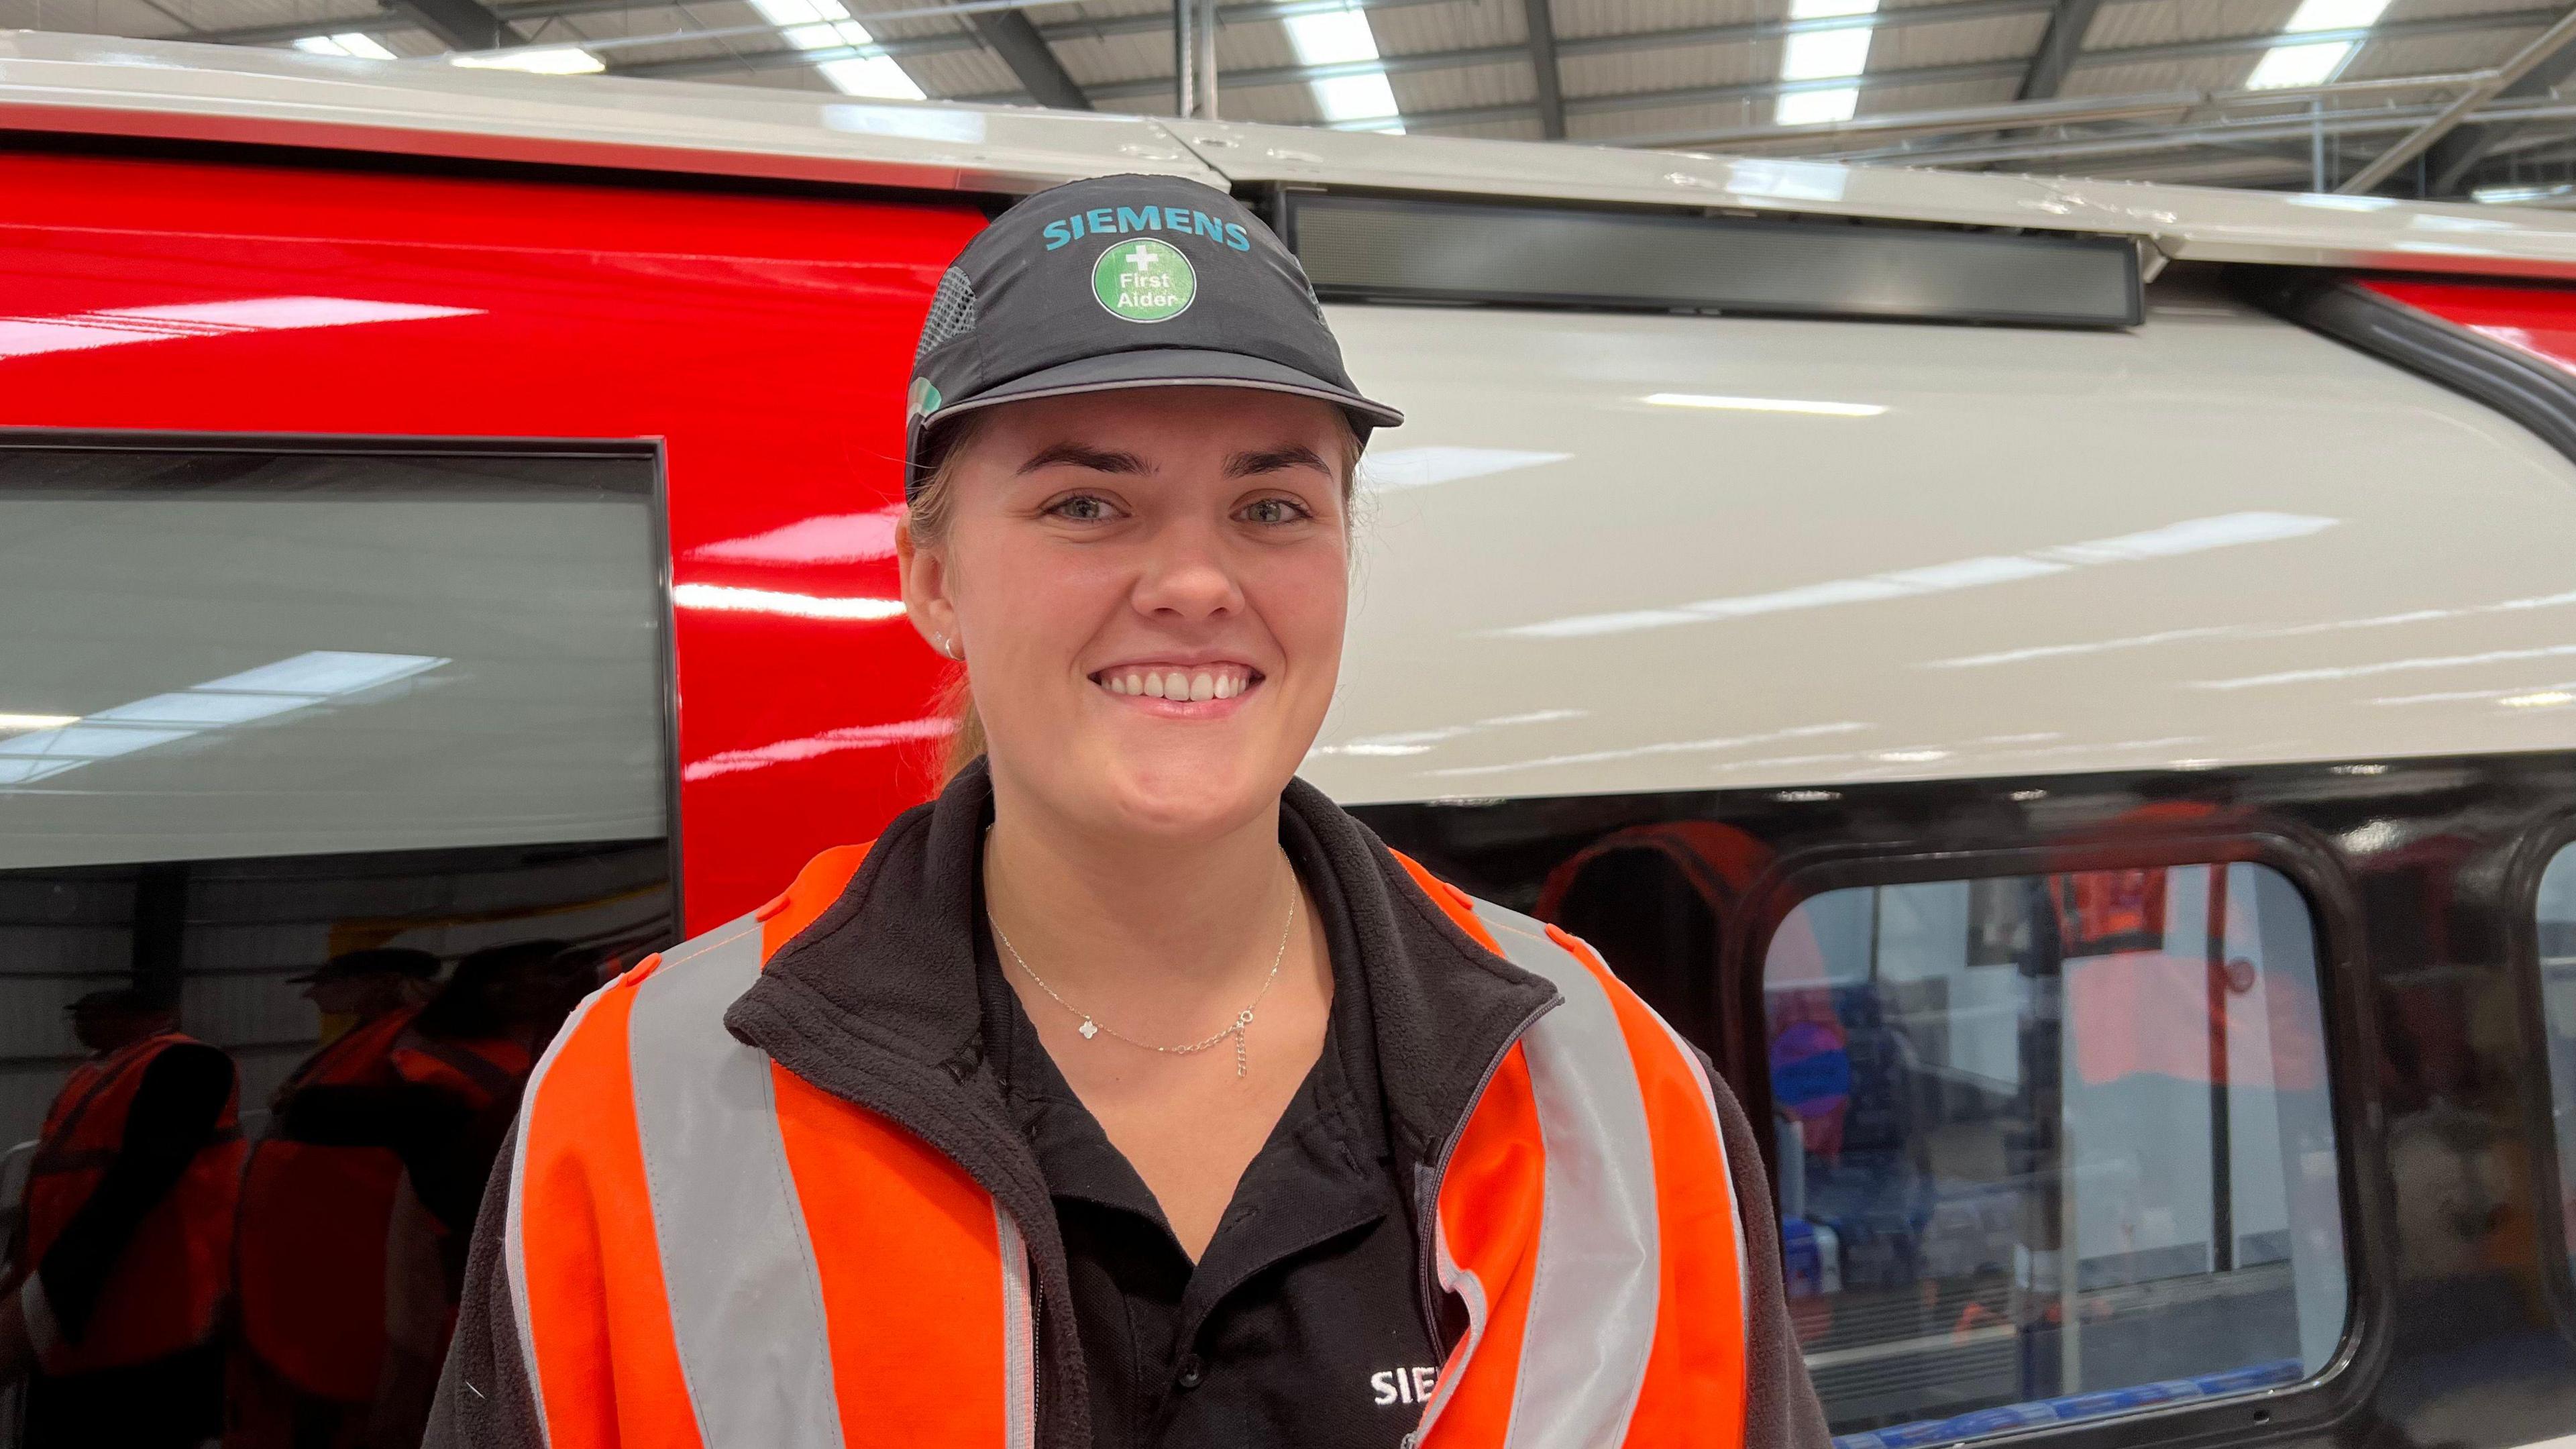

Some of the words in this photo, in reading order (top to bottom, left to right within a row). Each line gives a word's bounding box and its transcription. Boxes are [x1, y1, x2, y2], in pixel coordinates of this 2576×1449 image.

[1042, 205, 1250, 252] SIEMENS
[1120, 272, 1170, 288] First
[1117, 290, 1178, 308] Aider
[1371, 1366, 1441, 1405] SIE
